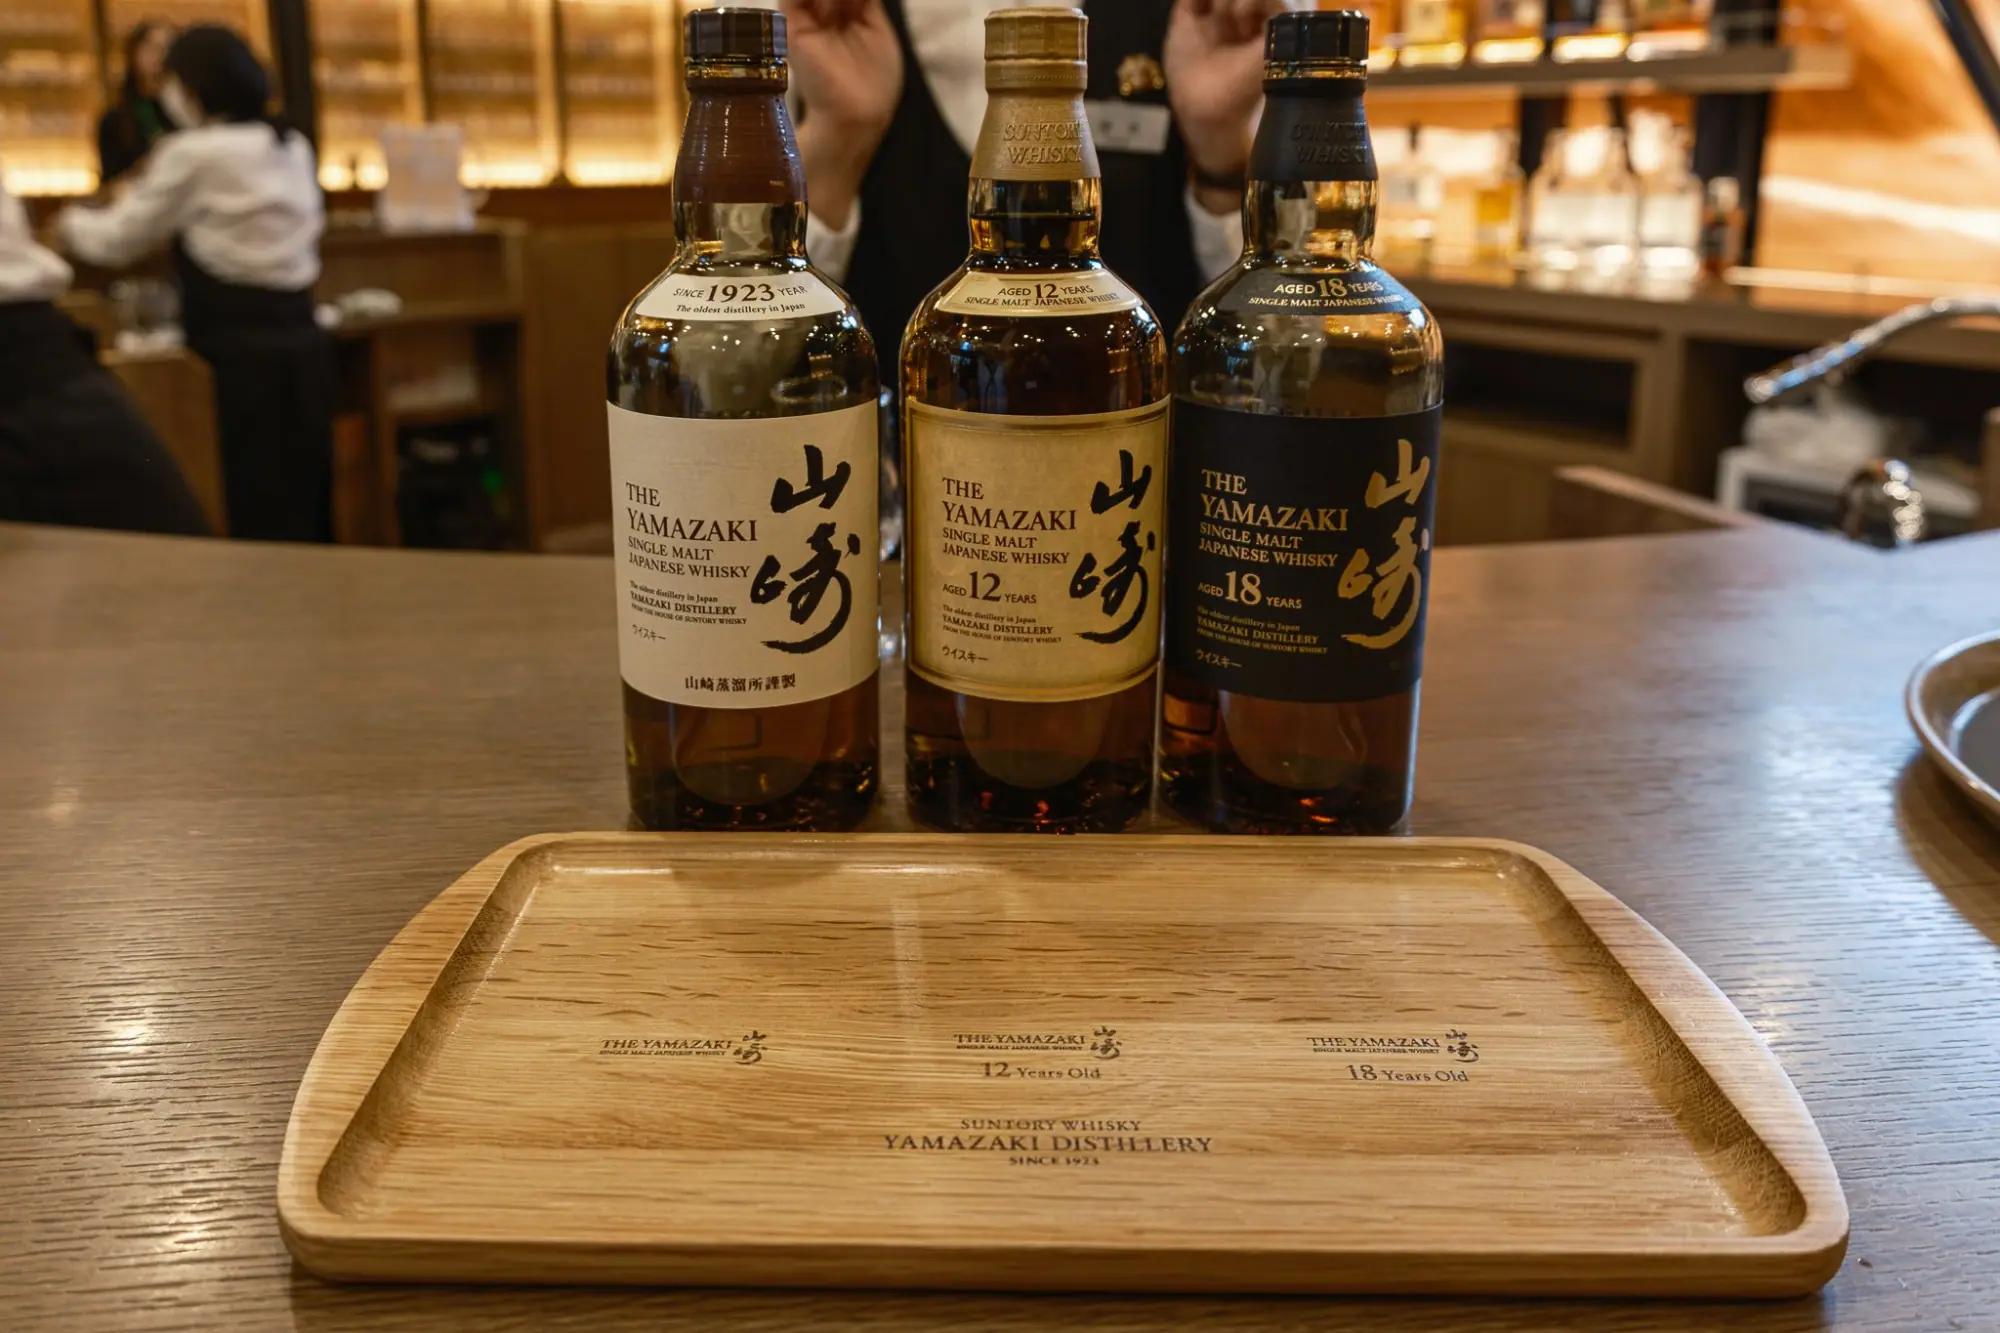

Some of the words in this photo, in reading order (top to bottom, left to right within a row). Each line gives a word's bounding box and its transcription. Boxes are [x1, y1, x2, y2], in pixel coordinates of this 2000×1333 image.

[673, 288, 705, 298] SINCE
[706, 283, 775, 302] 1923
[777, 285, 808, 297] YEAR
[997, 286, 1031, 296] AGED
[1034, 283, 1060, 299] 12
[1060, 284, 1094, 295] YEARS
[1274, 284, 1316, 294] AGED
[1316, 278, 1348, 297] 18
[1348, 281, 1384, 293] YEARS
[693, 305, 721, 313] oldest
[724, 304, 766, 314] distillery
[769, 304, 779, 312] in
[781, 303, 805, 313] Japan
[964, 296, 999, 305] SINGLE
[1001, 298, 1031, 306] MALT
[1034, 297, 1086, 306] JAPANESE
[1089, 292, 1120, 302] WHISKY
[1248, 297, 1288, 306] SINGLE
[1290, 299, 1322, 307] MALT
[1323, 297, 1376, 307] JAPANESE
[942, 477, 985, 500] THE
[1201, 469, 1248, 495] THE
[625, 481, 661, 507] THE
[942, 501, 1077, 531] YAMAZAKI
[1200, 494, 1349, 531] YAMAZAKI
[627, 507, 758, 542] YAMAZAKI
[942, 527, 990, 546] SINGLE
[994, 534, 1038, 549] MALT
[1200, 522, 1251, 544] SINGLE
[1256, 533, 1303, 549] MALT
[628, 535, 668, 557] SINGLE
[672, 545, 714, 561] MALT
[942, 542, 1008, 563] JAPANESE
[1012, 551, 1070, 565] WHISKY
[1199, 538, 1270, 563] JAPANESE
[1273, 551, 1338, 567] WHISKY
[629, 552, 686, 576] JAPANESE
[688, 564, 751, 578] WHISKY
[656, 588, 685, 601] distillery
[686, 592, 695, 601] in
[696, 594, 718, 604] Japan
[942, 583, 967, 596] AGED
[969, 570, 1002, 602] 12
[1004, 593, 1037, 604] YEARS
[1198, 582, 1224, 597] AGED
[1225, 570, 1262, 605] 18
[1266, 596, 1302, 609] YEARS
[630, 590, 671, 610] YAMAZAKI
[674, 602, 737, 615] DISTILLERY
[632, 623, 666, 641] ウイスキー
[942, 614, 990, 631] YAMAZAKI
[993, 624, 1054, 634] DISTILLERY
[1198, 615, 1248, 637] YAMAZAKI
[1252, 629, 1319, 644] DISTILLERY
[942, 644, 988, 663] ウイスキー
[1196, 648, 1243, 668] ウイスキー
[600, 1039, 638, 1049] THE
[643, 1039, 733, 1049] YAMAZAKI
[953, 1034, 992, 1044] THE
[993, 1034, 1085, 1044] YAMAZAKI
[1306, 1037, 1346, 1047] THE
[1347, 1037, 1441, 1047] YAMAZAKI
[981, 1062, 1011, 1078] 12
[1017, 1067, 1063, 1079] Years
[1067, 1067, 1100, 1079] Old
[1346, 1064, 1378, 1081] 18
[1382, 1069, 1431, 1082] Years
[1435, 1070, 1469, 1082] Old
[960, 1119, 1056, 1131] SUNTORY
[1063, 1120, 1142, 1132] WHISKY
[883, 1134, 1040, 1151] YAMAZAKI
[1052, 1135, 1212, 1152] DISTILLERY
[1009, 1155, 1059, 1166] SINCE
